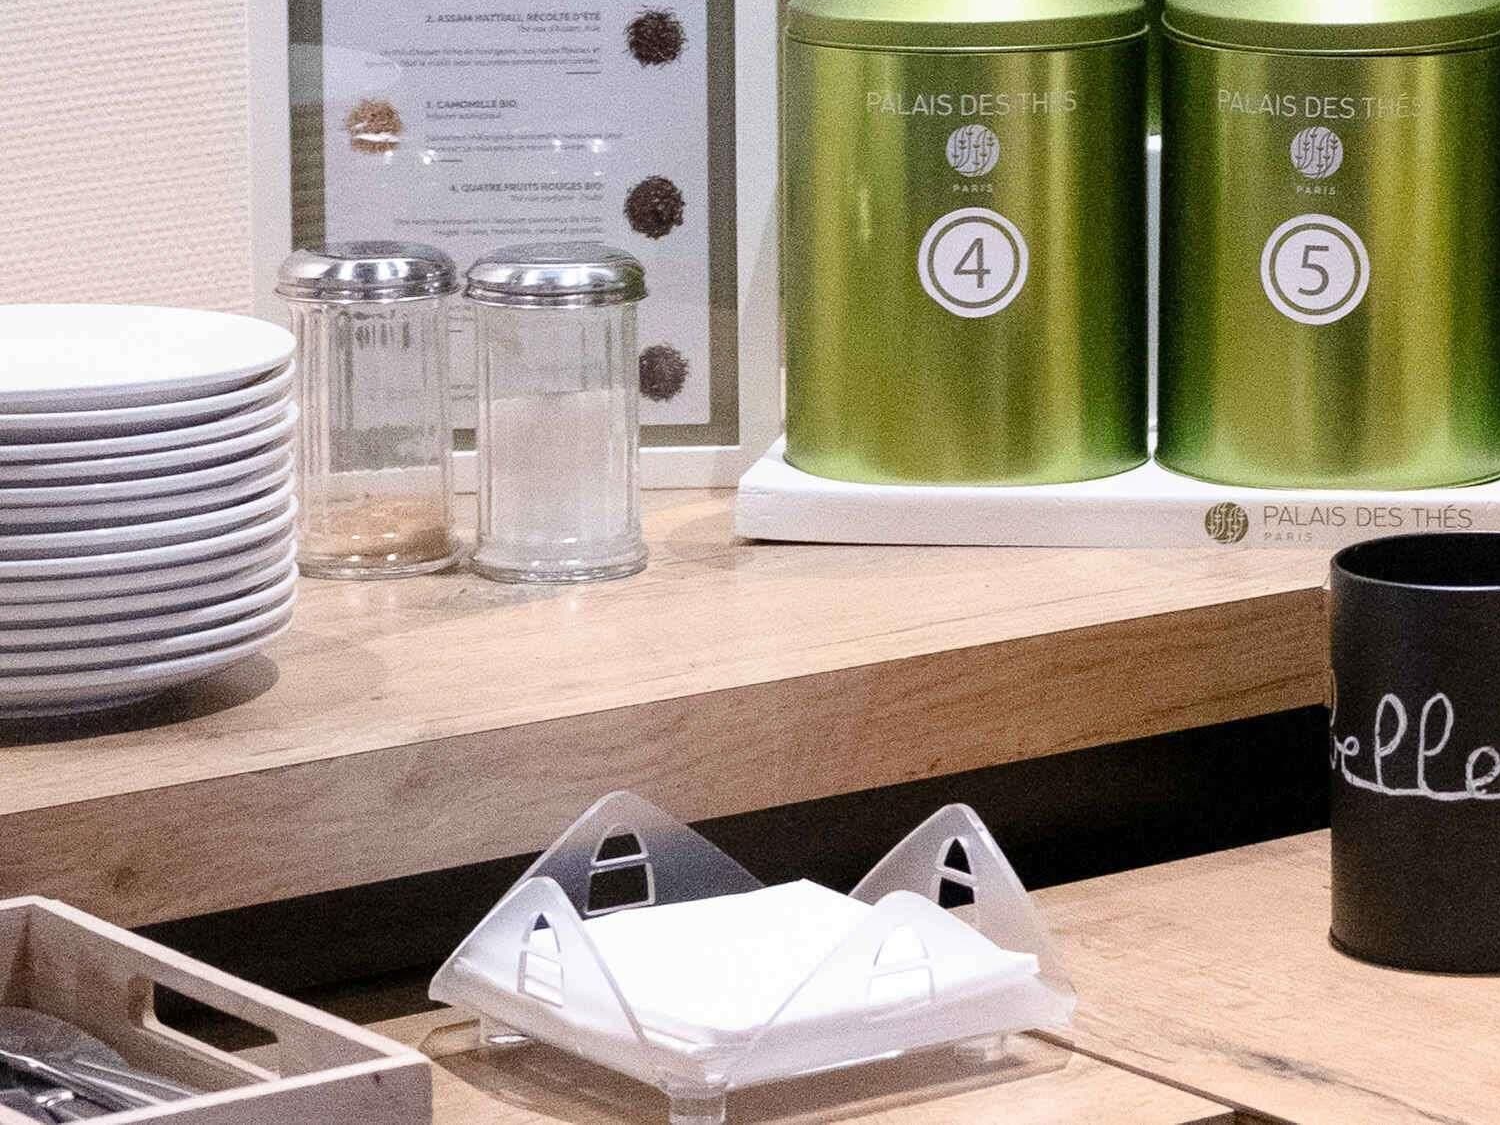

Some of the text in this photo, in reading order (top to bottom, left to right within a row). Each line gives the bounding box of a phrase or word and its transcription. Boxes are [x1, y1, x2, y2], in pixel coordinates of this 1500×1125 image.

[866, 89, 1078, 117] PALAIS DES THS
[1217, 90, 1297, 118] PALAIS
[1305, 95, 1356, 119] DES
[952, 183, 994, 193] PARIS
[1296, 185, 1337, 196] PARIS
[952, 237, 992, 289] 4
[1297, 244, 1330, 296] 5
[1263, 504, 1473, 529] PALAIS DES THÉS
[1263, 531, 1313, 542] PARIS
